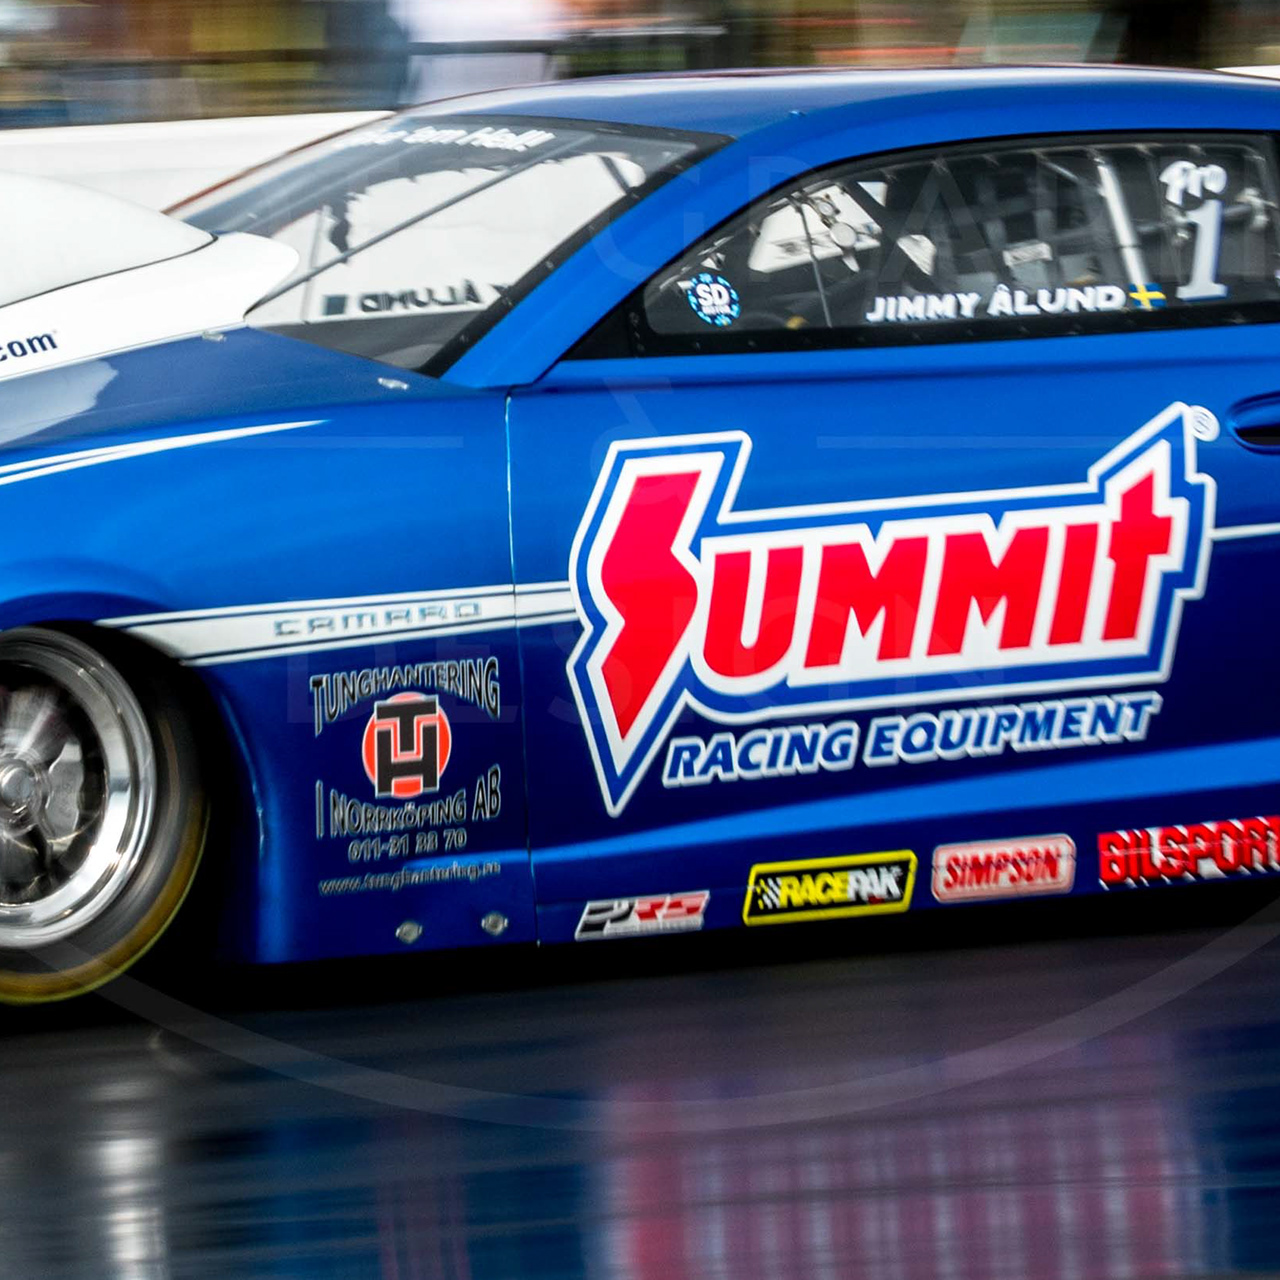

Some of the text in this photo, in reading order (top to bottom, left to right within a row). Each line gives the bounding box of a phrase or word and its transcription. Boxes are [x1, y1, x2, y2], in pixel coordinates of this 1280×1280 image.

[1175, 198, 1228, 301] 1
[695, 282, 731, 306] SD
[866, 283, 1127, 323] JIMMY ÅLUND
[273, 601, 483, 637] CAMARO
[309, 656, 501, 738] TUNGHANTERING
[666, 693, 1161, 786] RACING EQUIPMENT
[329, 788, 467, 837] NORRKÖPING
[472, 763, 502, 821] AB
[778, 865, 902, 907] RACEPAK
[943, 845, 1061, 889] SIMPSON
